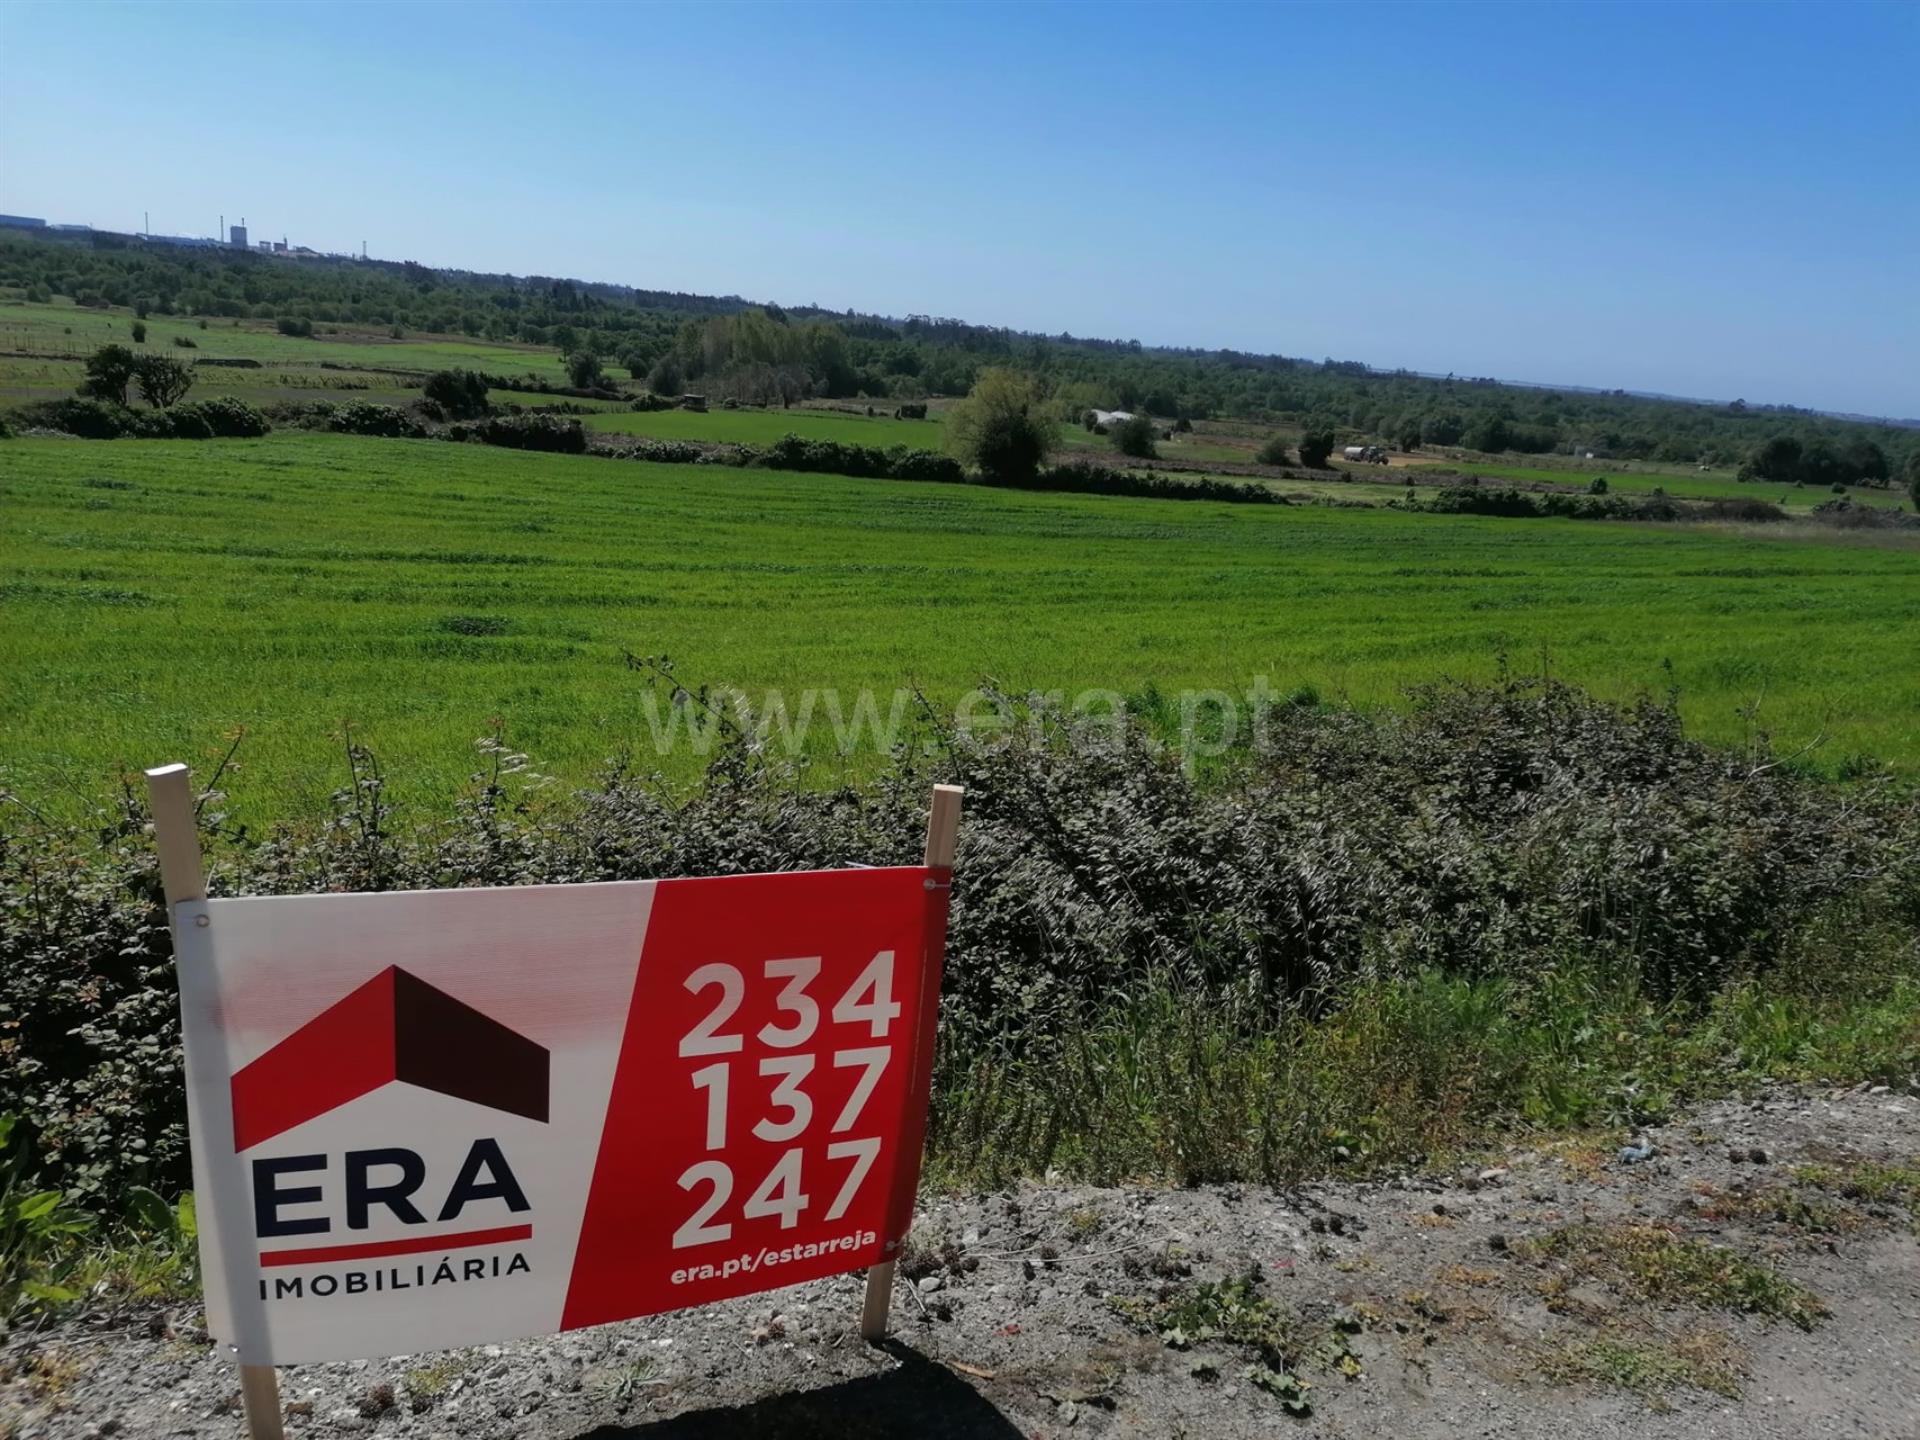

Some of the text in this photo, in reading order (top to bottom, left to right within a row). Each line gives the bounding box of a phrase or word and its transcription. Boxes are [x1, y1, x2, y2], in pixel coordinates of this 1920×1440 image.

[678, 950, 902, 1058] 234
[690, 1045, 892, 1151] 137
[252, 1137, 531, 1238] ERA
[671, 1136, 882, 1250] 247
[258, 1252, 531, 1301] IMOBILIÁRIA
[670, 1227, 877, 1286] era.pt/estarreja
